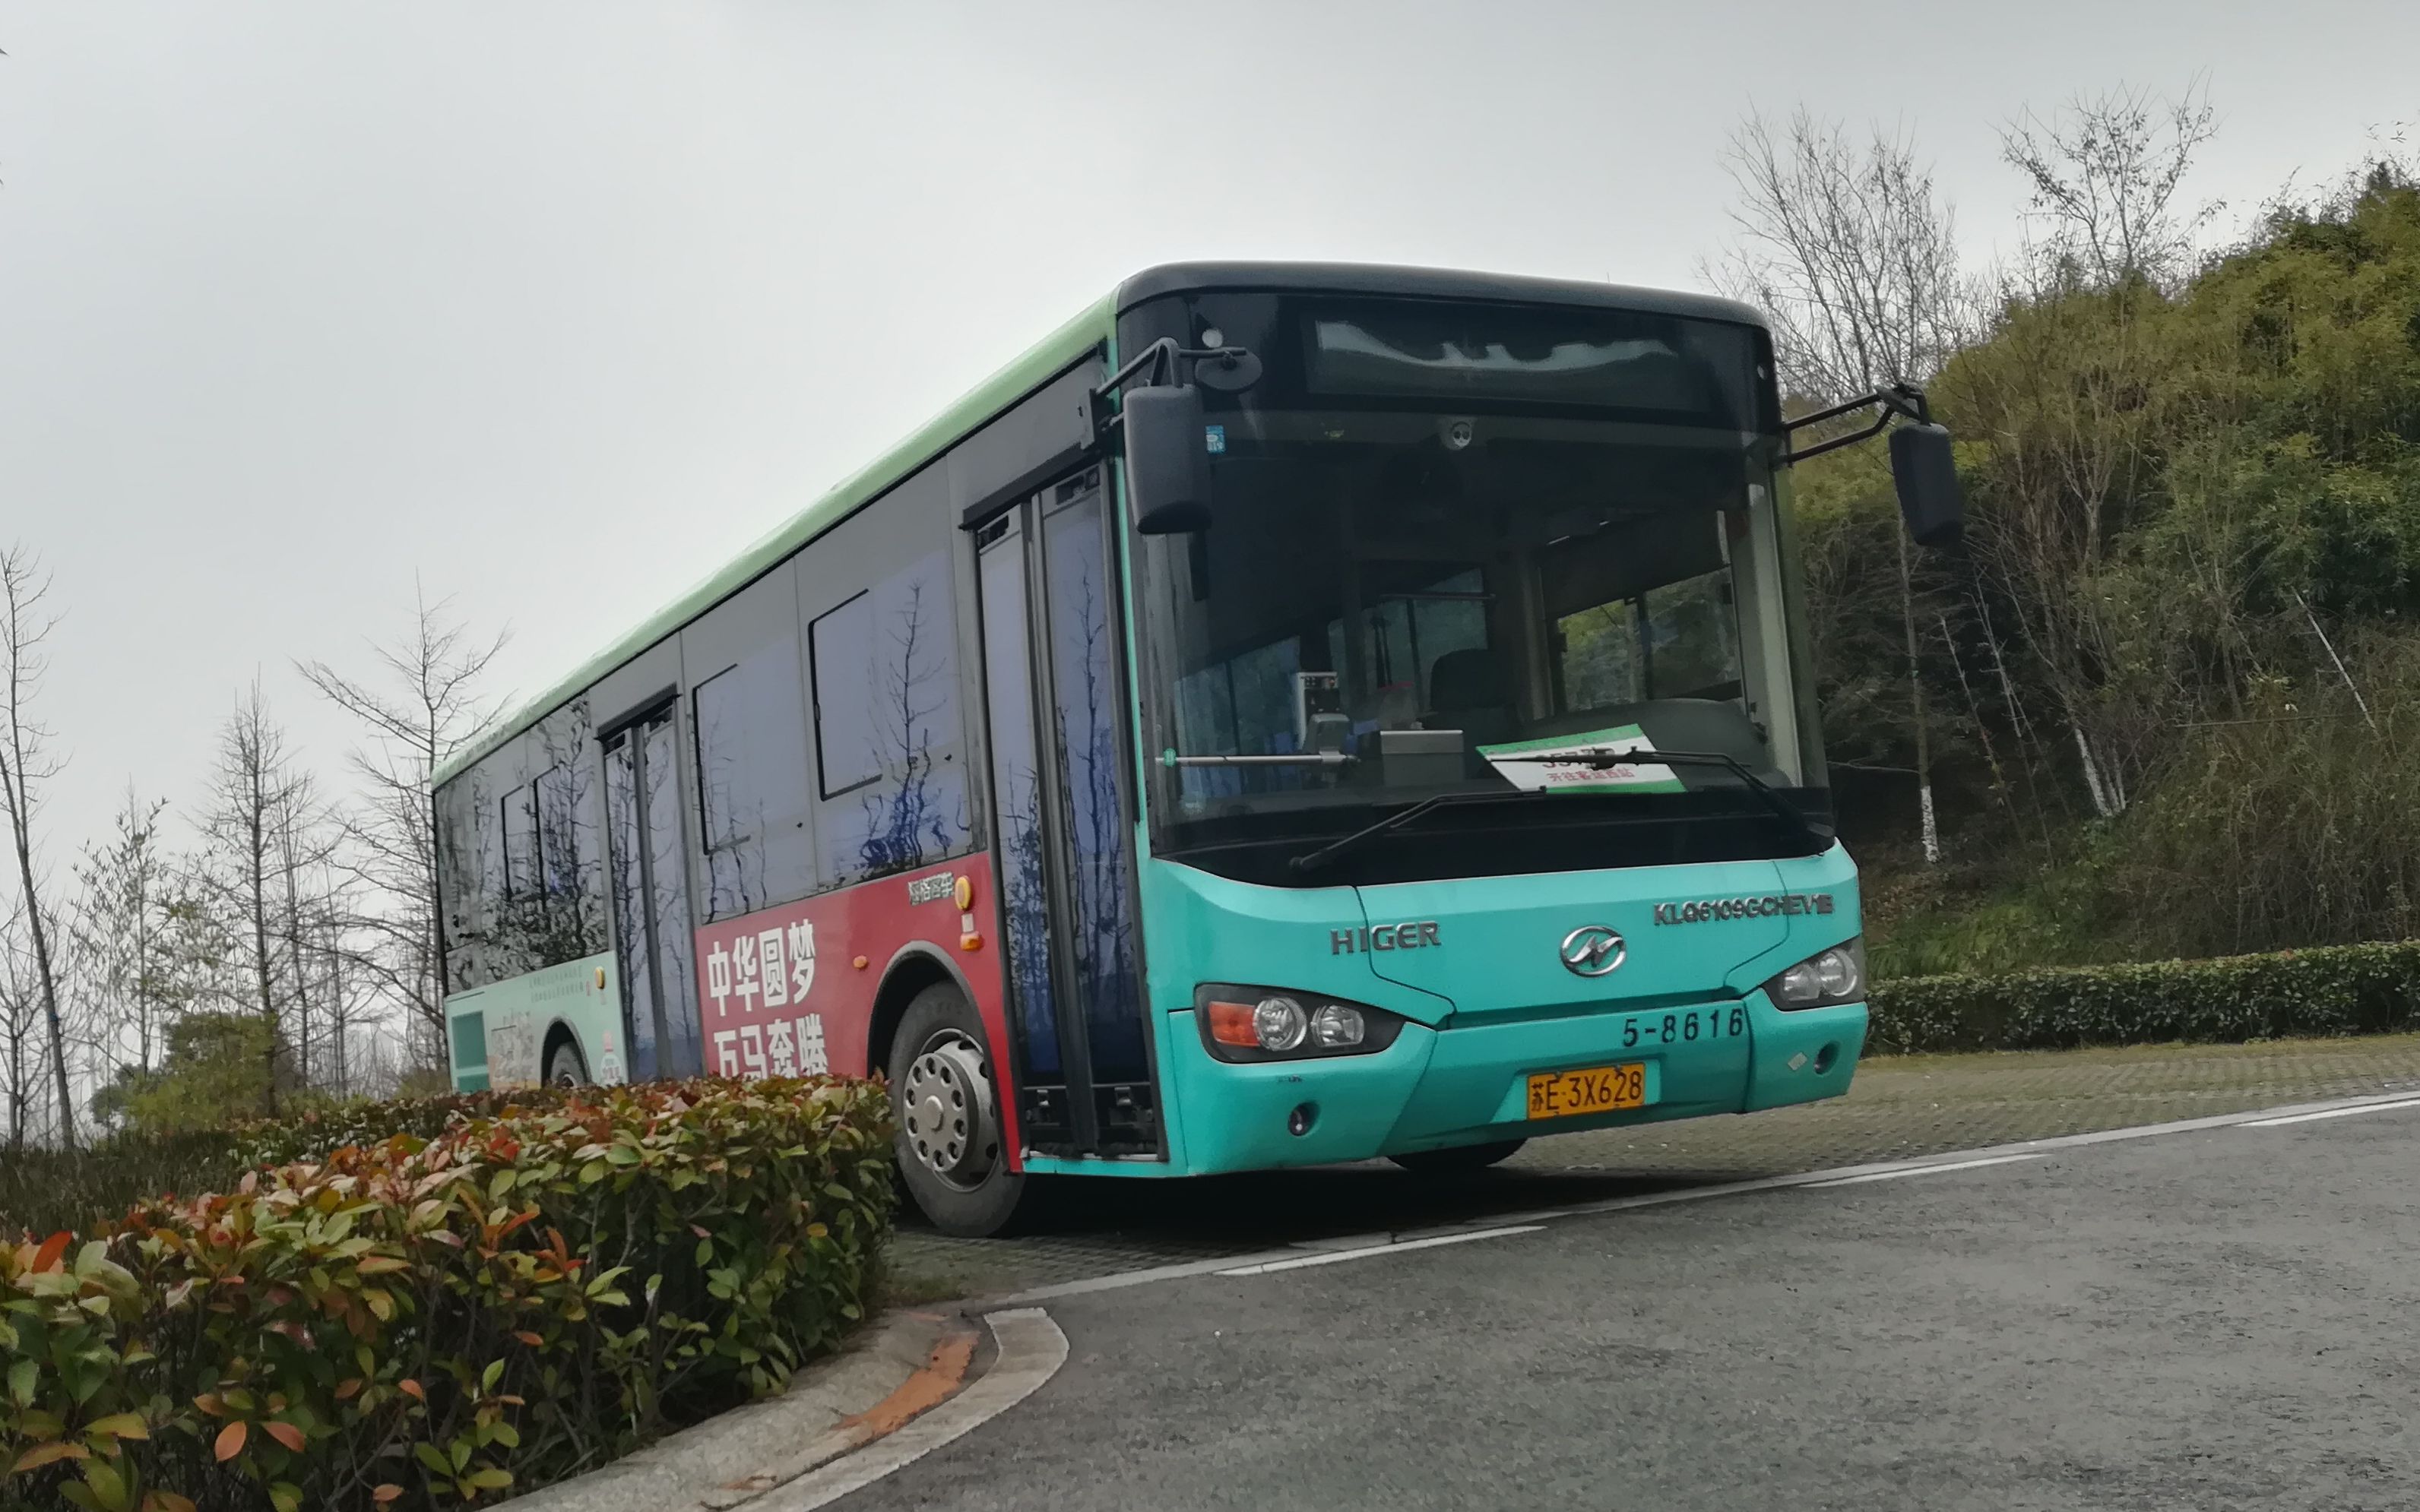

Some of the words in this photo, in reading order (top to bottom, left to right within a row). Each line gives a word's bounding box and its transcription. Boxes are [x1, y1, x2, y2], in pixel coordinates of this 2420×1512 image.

[1331, 920, 1442, 955] HIGER
[707, 919, 816, 1017] 中华圆梦
[714, 1013, 828, 1080] 万马奔腾
[1623, 1008, 1743, 1047] 5-8616
